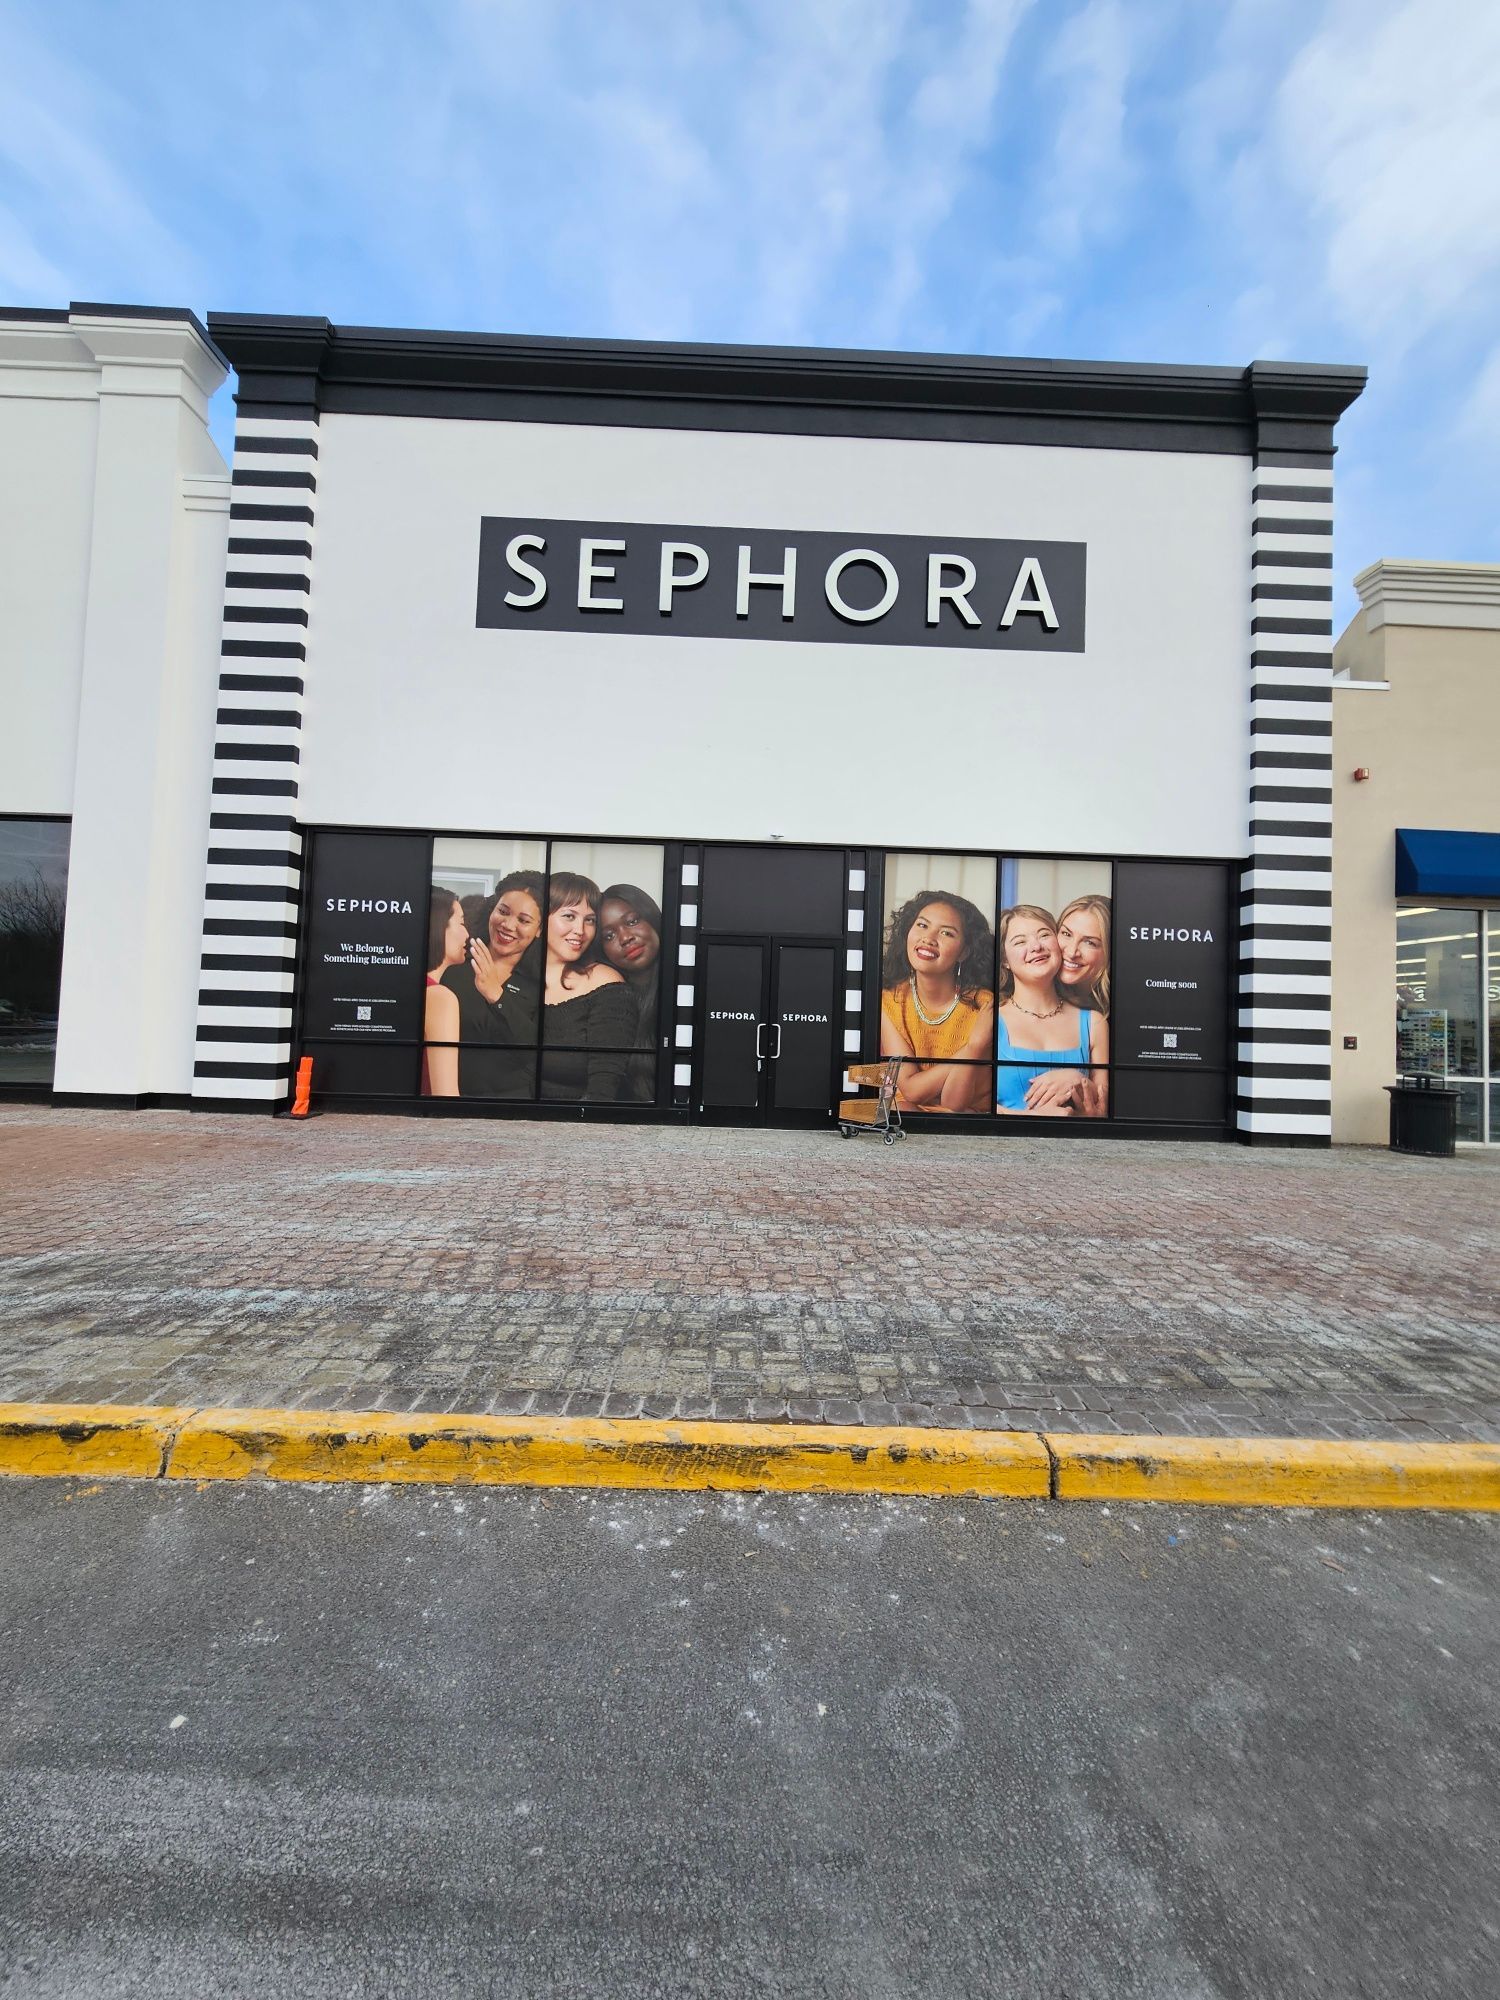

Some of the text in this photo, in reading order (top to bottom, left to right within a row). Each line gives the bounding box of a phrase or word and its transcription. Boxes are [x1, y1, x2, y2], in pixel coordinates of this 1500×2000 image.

[503, 534, 1060, 631] SEPHORA
[326, 898, 412, 914] SEPHORA
[1130, 927, 1214, 943] SEPHORA
[340, 943, 395, 954] We Belong to
[323, 954, 409, 965] Something Beautiful
[1145, 978, 1198, 989] Coming soon
[710, 1011, 756, 1021] SEPHORA
[782, 1013, 828, 1023] SEPHORA
